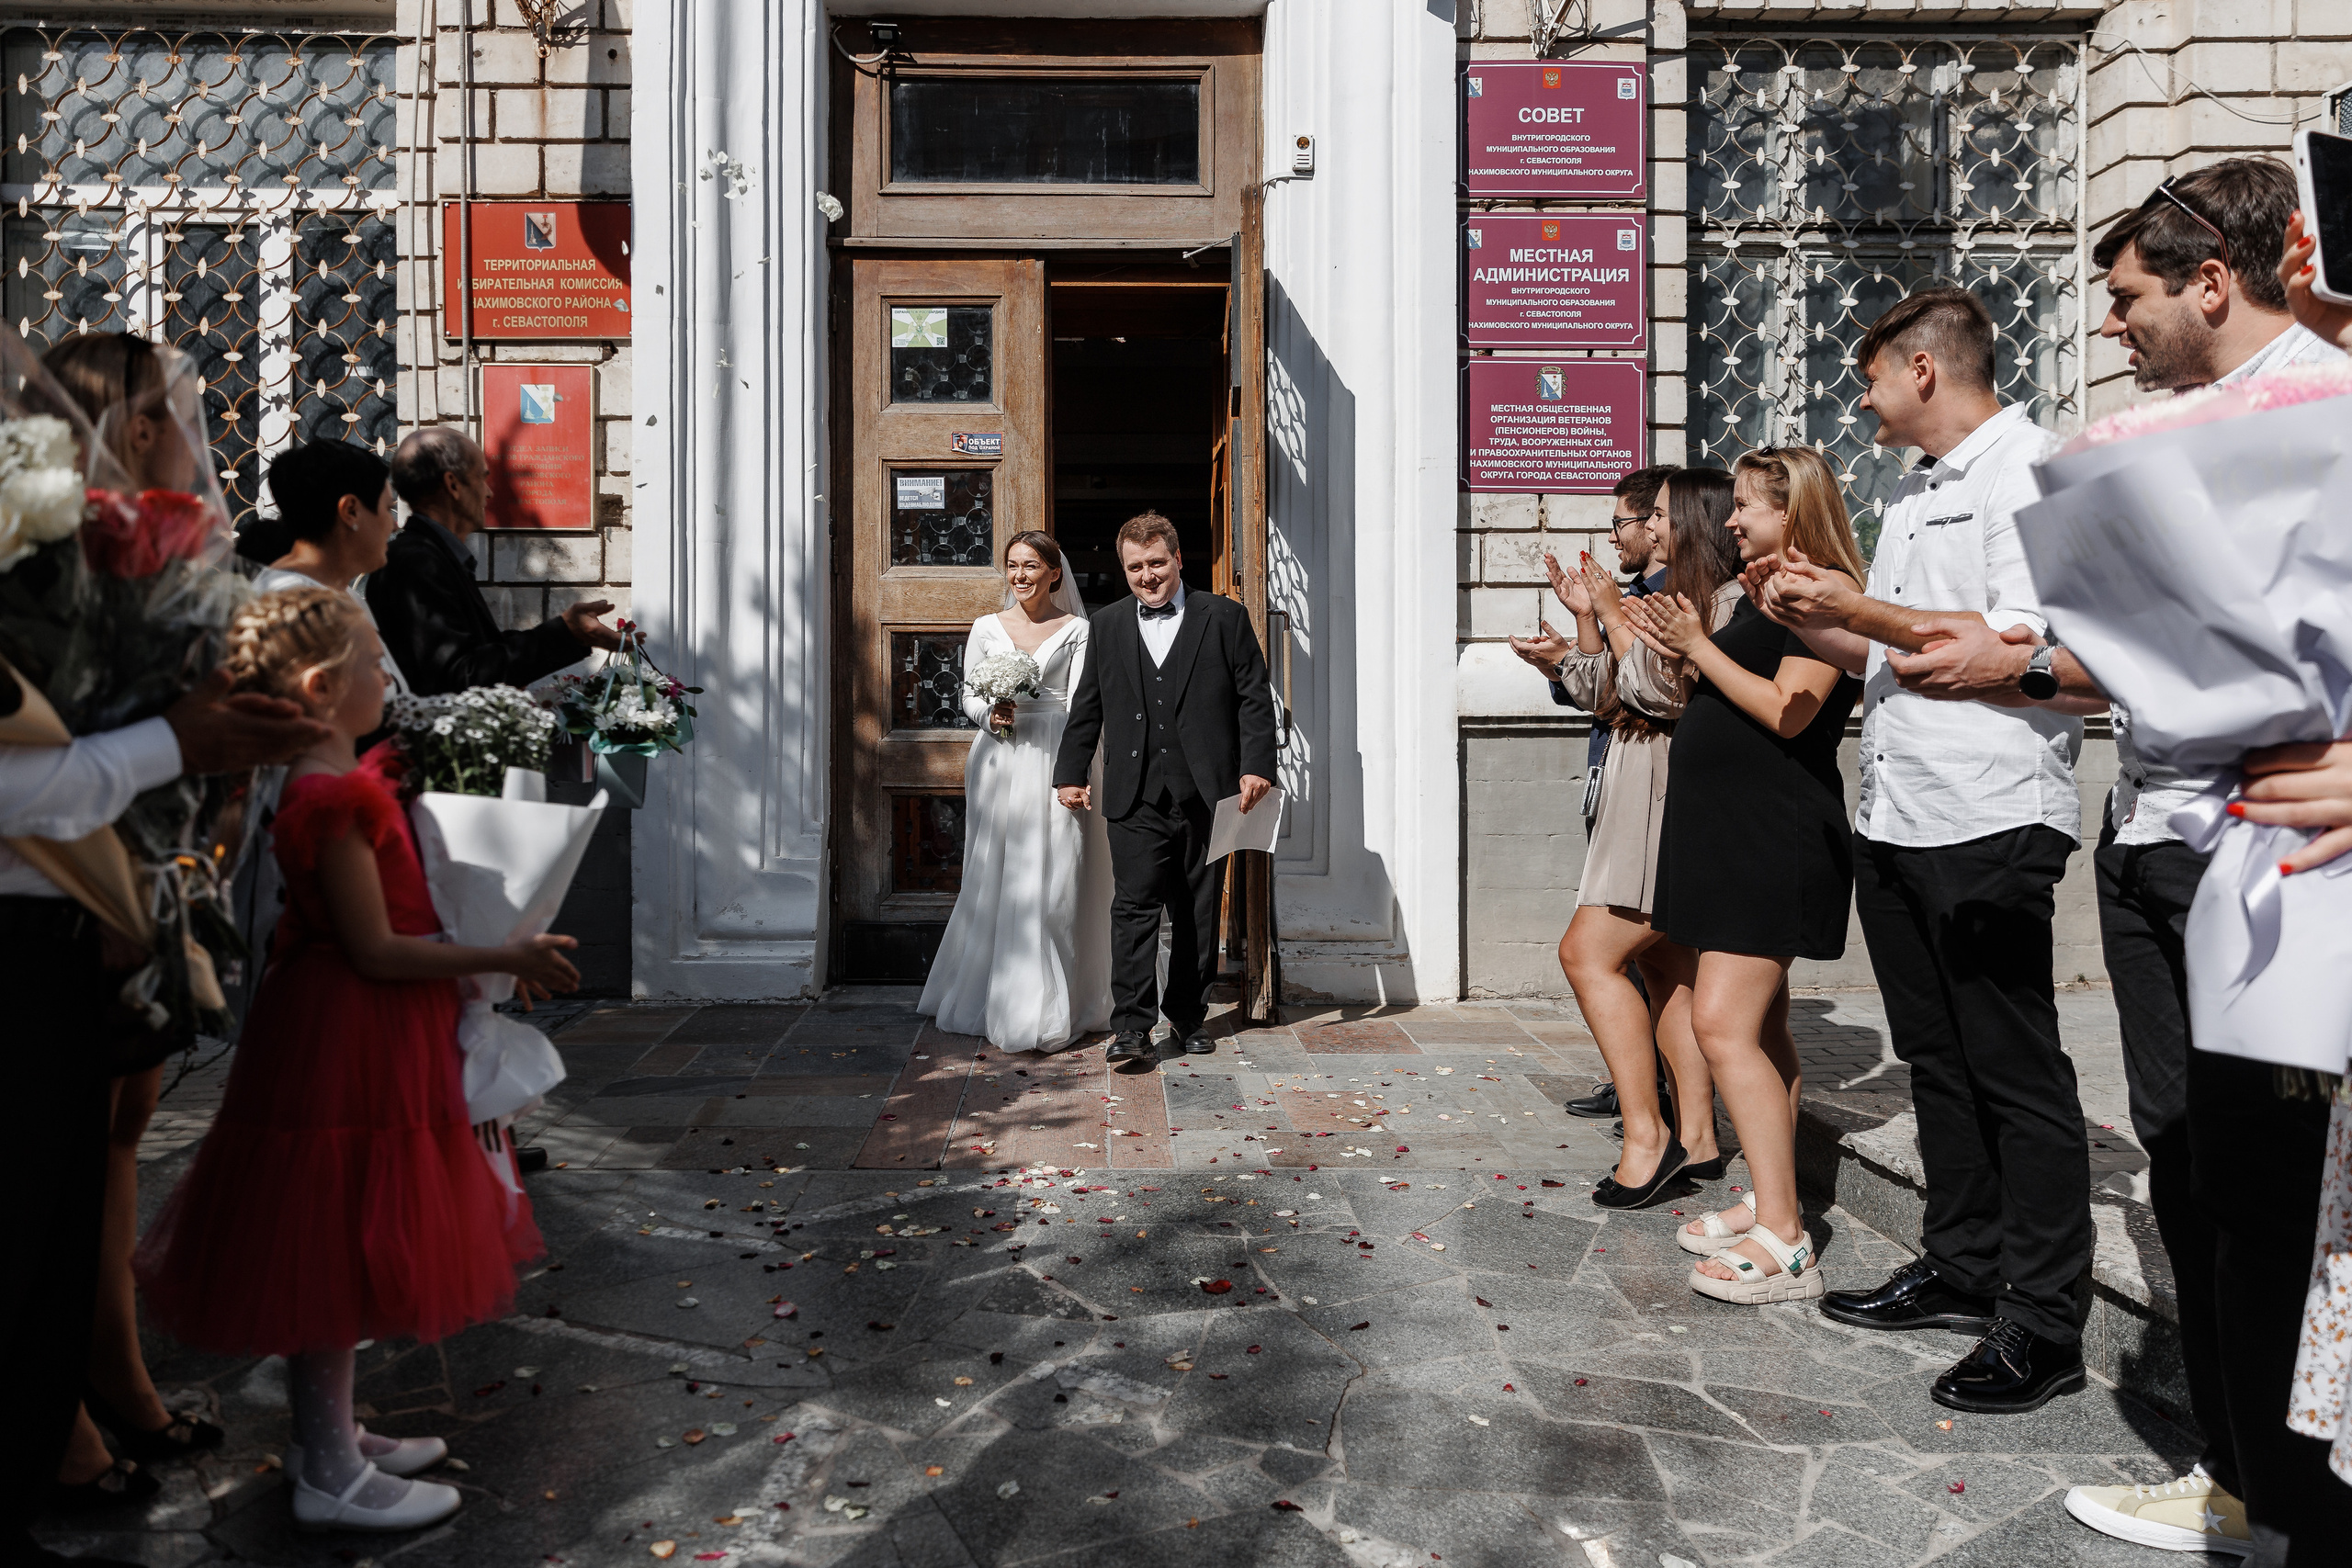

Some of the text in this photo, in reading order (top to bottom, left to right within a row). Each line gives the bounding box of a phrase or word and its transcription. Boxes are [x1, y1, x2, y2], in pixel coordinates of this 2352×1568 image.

[1518, 107, 1584, 123] СОВЕТ
[1510, 249, 1593, 262] МЕСТНАЯ
[483, 259, 595, 271] ТЕРРИТОРИАЛЬНАЯ
[1474, 268, 1629, 284] АДМИНИСТРАЦИЯ
[458, 278, 623, 289] ИБИРАТЕЛЬНАЯ КОМИССИЯ
[565, 295, 611, 309] РАЙОНА
[492, 316, 588, 328] г. СЕВАСТОПОЛЯ
[1536, 405, 1611, 413] ОБЩЕСТВЕННАЯ
[1490, 416, 1611, 424] ОРГАНИЗАЦИЯ ВЕТЕРАНОВ
[1495, 426, 1607, 436] (ПЕНСИОНЕРОВ) ВОЙНЫ,
[1489, 438, 1520, 446] ТРУДА,
[1522, 438, 1591, 446] ВООРУЖЕННЫХ
[1478, 449, 1588, 457] ПРАВООХРАНИТЕЛЬНЫХ
[1545, 461, 1632, 469] МУНИЦИПАЛЬНОГО
[1516, 471, 1552, 479] ГОРОДА
